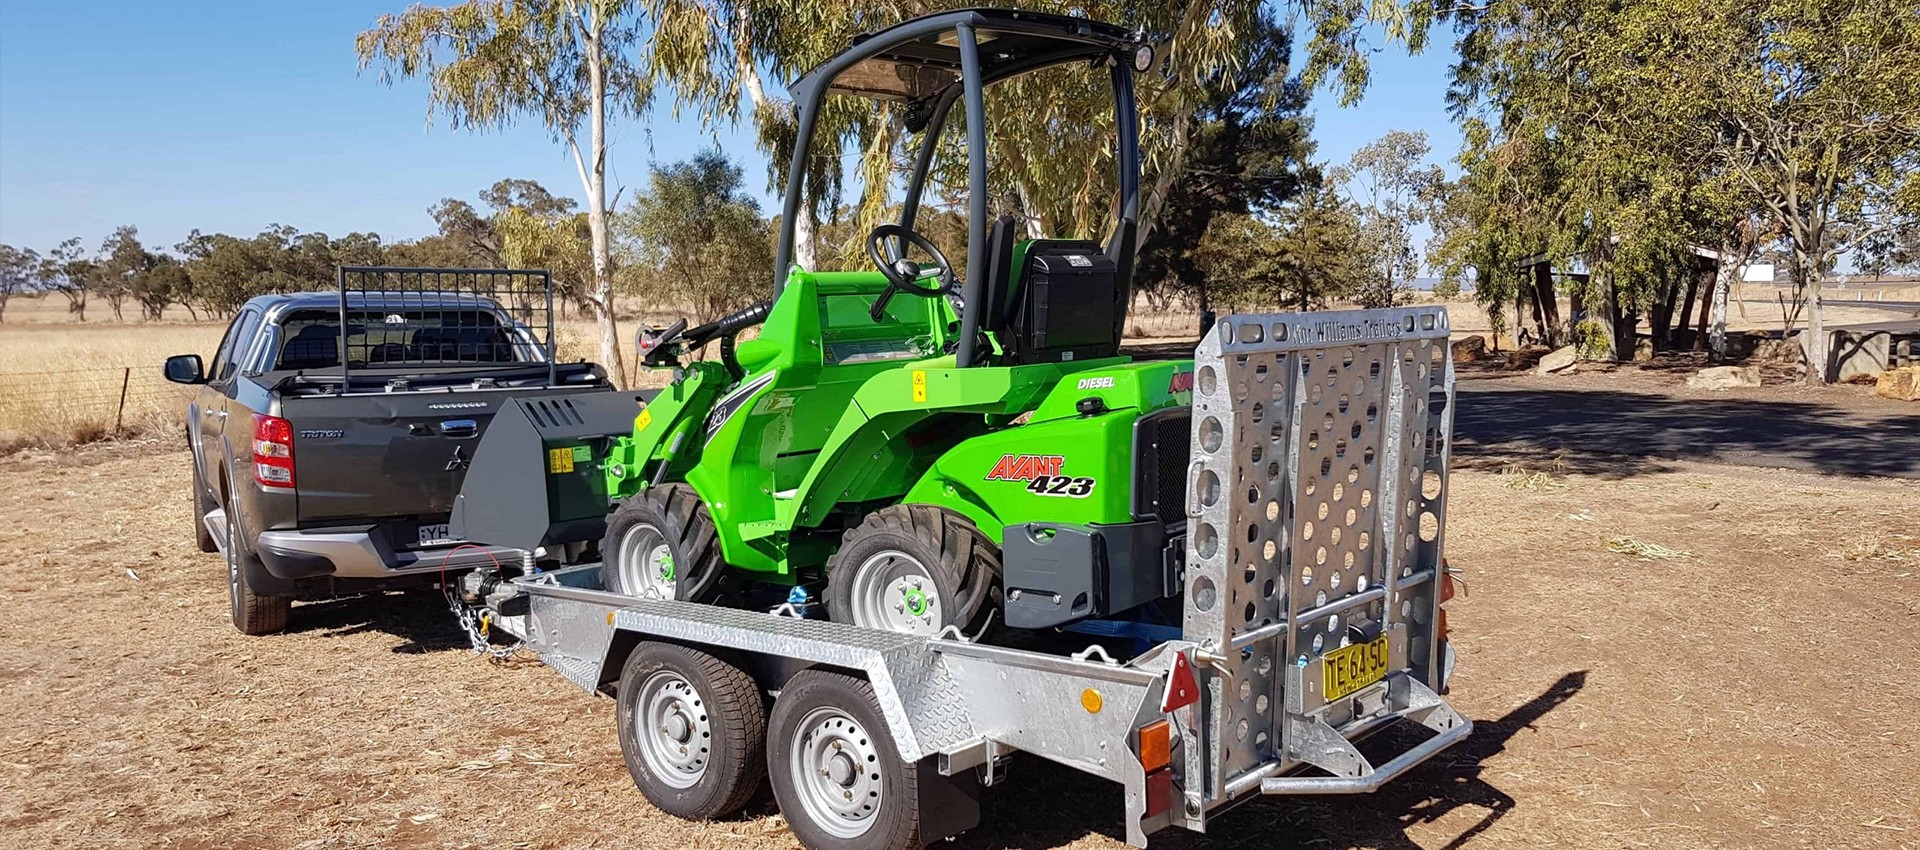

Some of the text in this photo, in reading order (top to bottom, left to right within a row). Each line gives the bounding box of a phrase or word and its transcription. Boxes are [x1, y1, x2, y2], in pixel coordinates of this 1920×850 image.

[1315, 320, 1362, 343] Williams
[1364, 319, 1402, 339] Trailers
[1077, 376, 1115, 390] DIESEL
[300, 429, 344, 438] TRITON
[984, 454, 1065, 482] AVANT
[1026, 475, 1096, 498] 423
